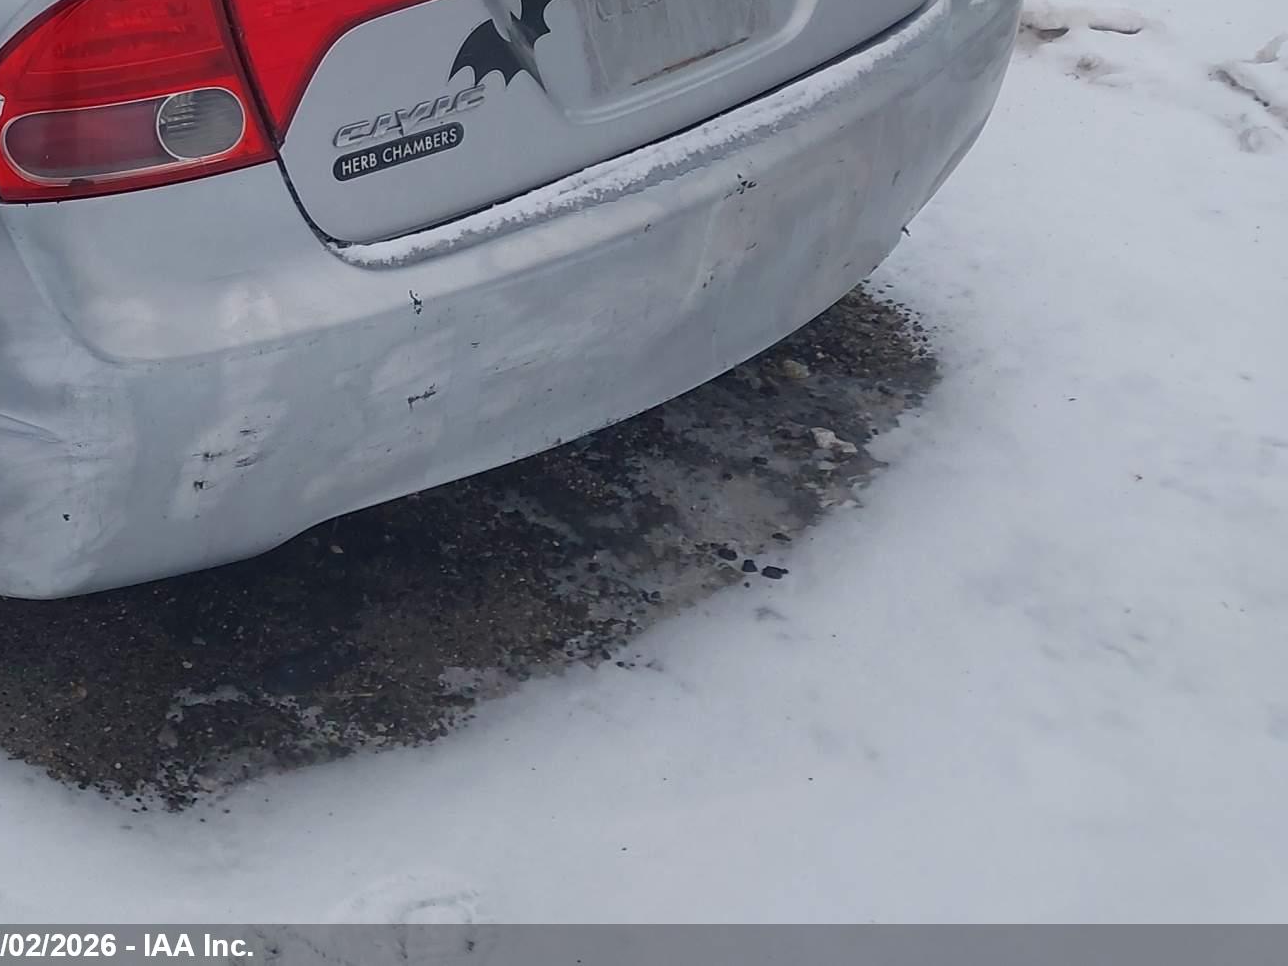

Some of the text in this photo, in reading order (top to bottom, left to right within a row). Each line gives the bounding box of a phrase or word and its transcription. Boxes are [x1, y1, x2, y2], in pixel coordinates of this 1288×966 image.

[333, 84, 486, 147] CIVIC
[341, 127, 458, 176] HERB CHAMBERS
